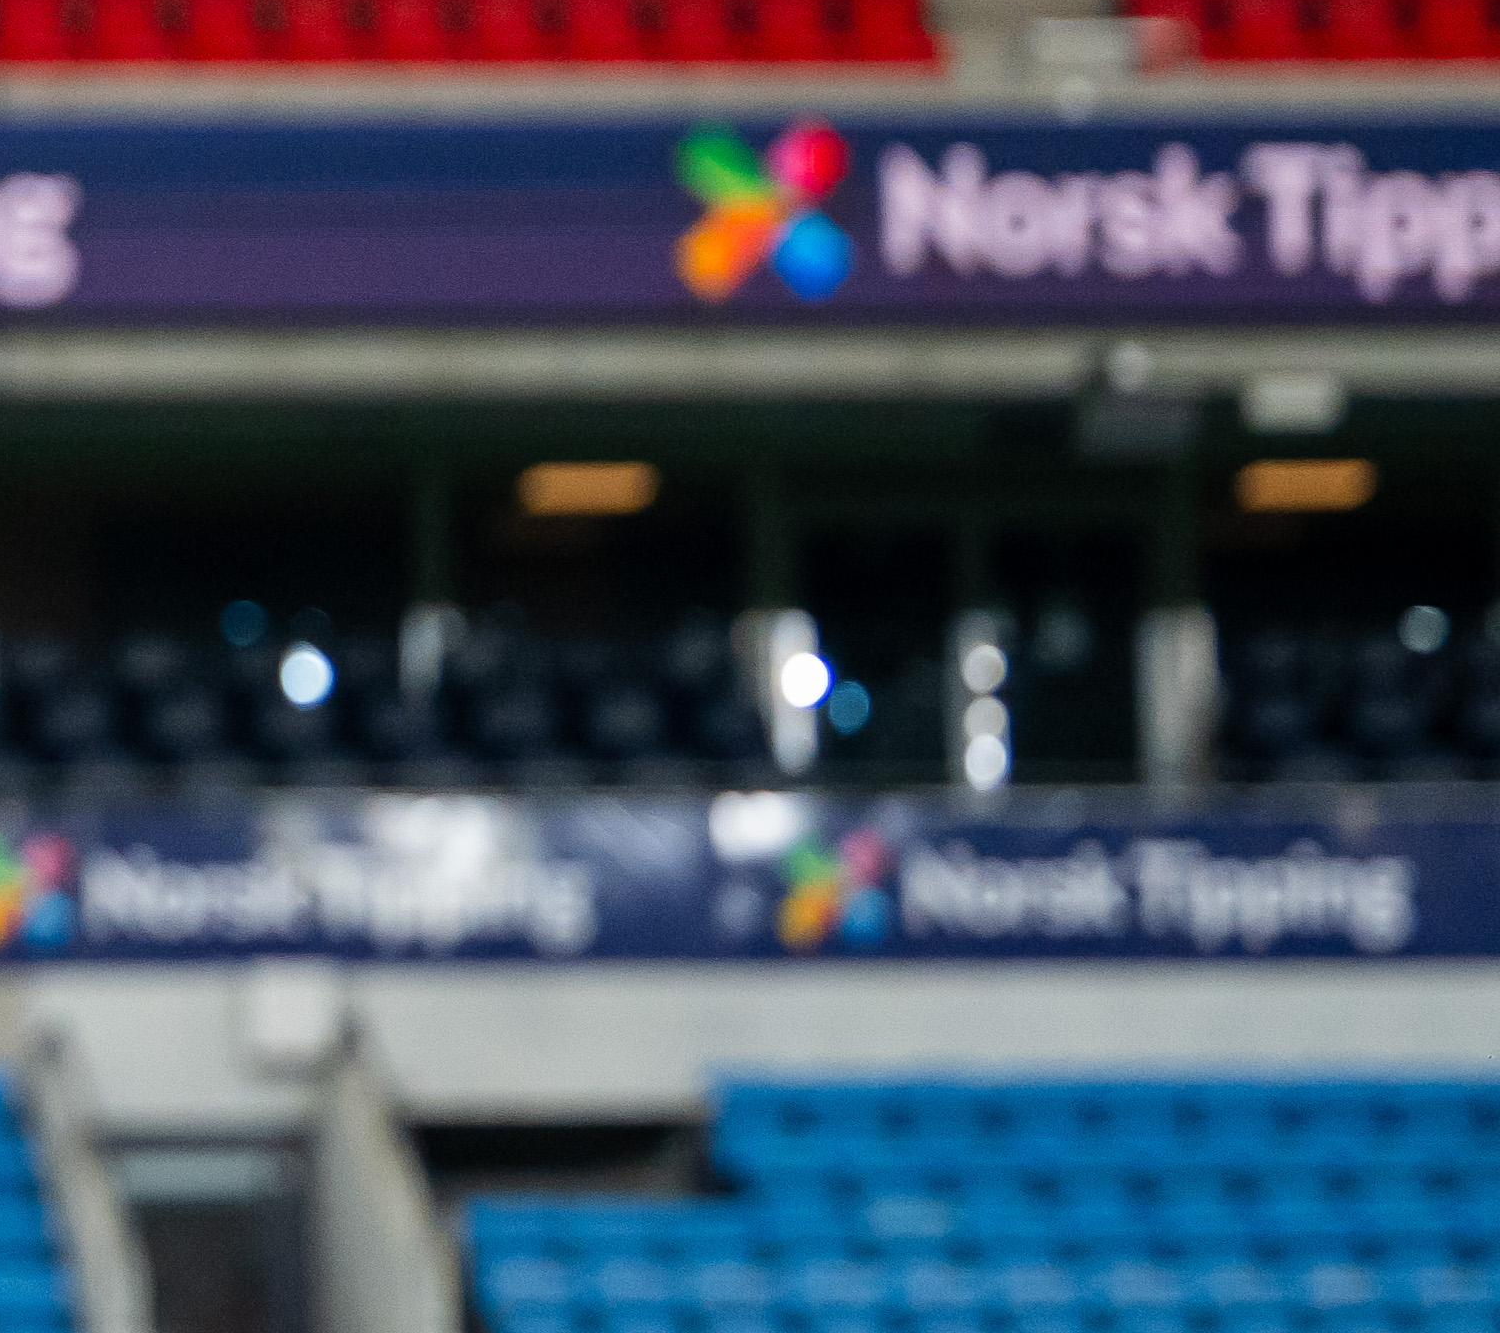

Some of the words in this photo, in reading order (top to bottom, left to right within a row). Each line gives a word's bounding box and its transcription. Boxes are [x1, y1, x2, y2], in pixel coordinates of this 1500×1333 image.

[878, 141, 1242, 277] Norsk
[904, 838, 1128, 937] Norsk
[1126, 837, 1416, 953] Tipping
